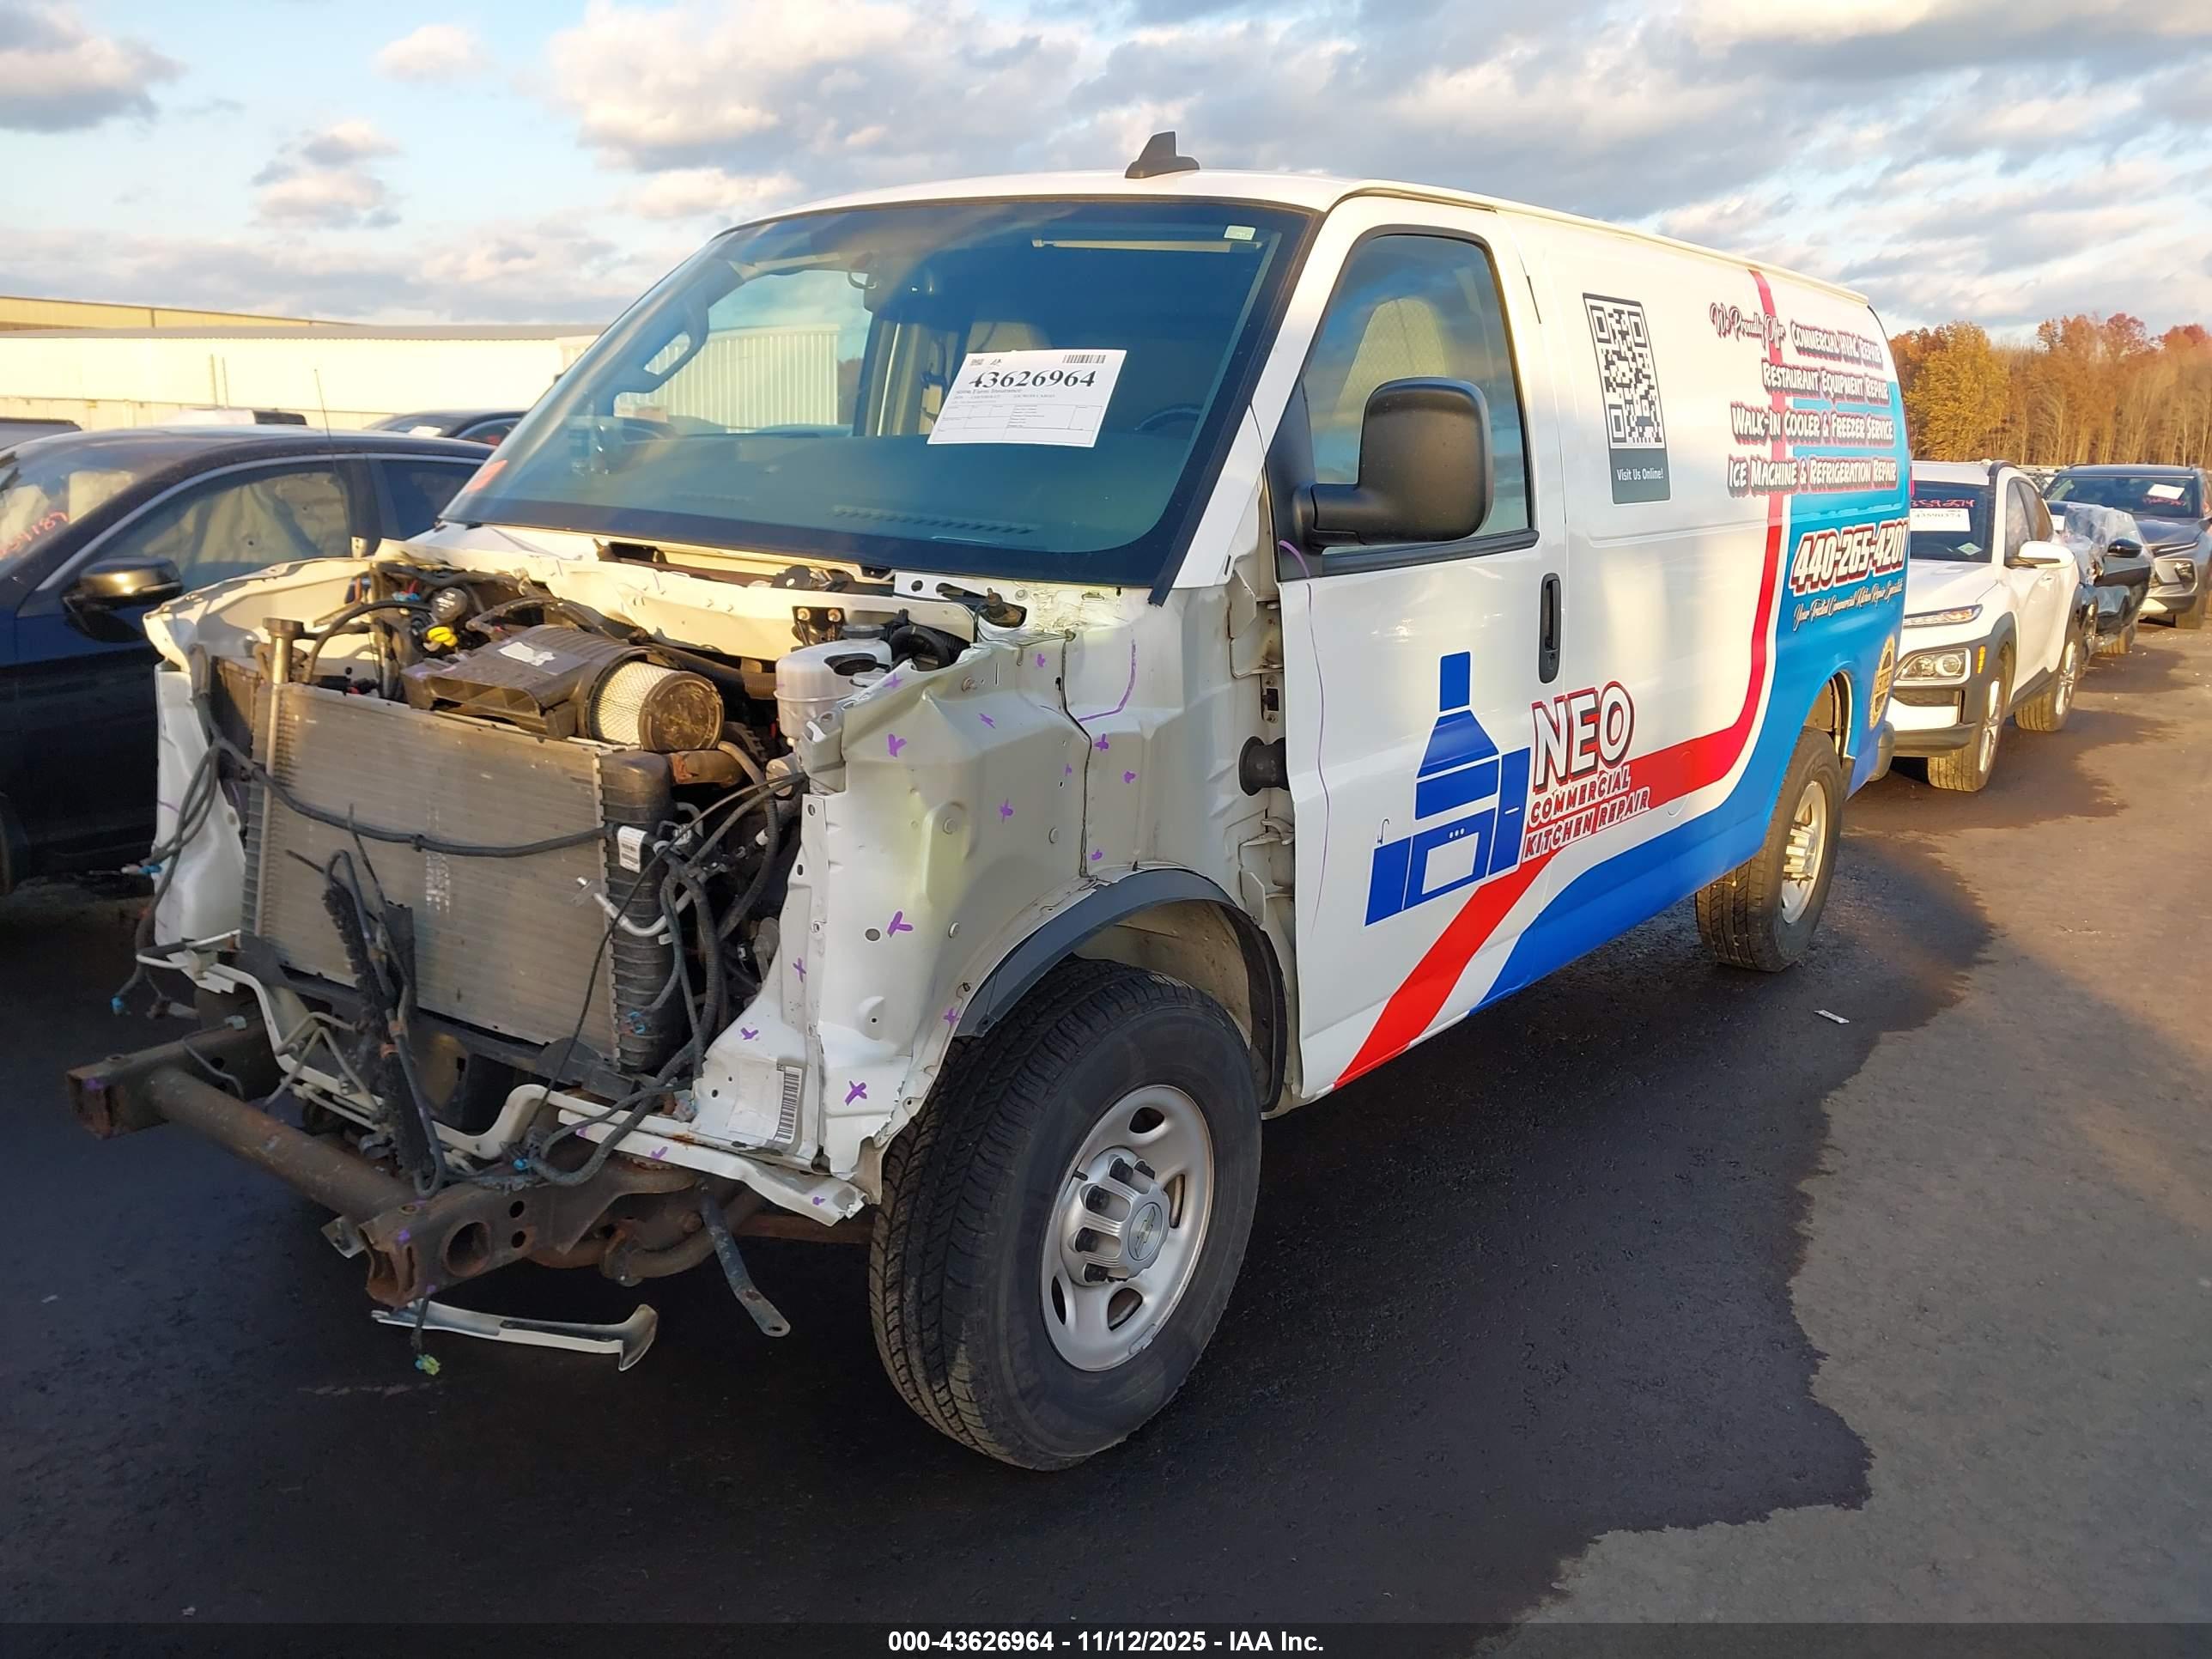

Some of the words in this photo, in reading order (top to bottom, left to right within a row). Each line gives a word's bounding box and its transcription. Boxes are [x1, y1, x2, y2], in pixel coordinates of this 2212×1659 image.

[1710, 302, 1731, 337] We
[1729, 305, 1766, 349] Proudly
[1763, 312, 1786, 349] Offer
[1790, 321, 1840, 356] COMMERCIAL
[1838, 331, 1860, 361] HVAC
[1859, 336, 1883, 366] REPAIR
[969, 370, 1097, 388] 43626964
[1762, 358, 1820, 393] RESTAURANT
[1820, 368, 1864, 399] EQUIPMENT
[1865, 375, 1889, 402] REPAIR
[1731, 405, 1781, 441] WALK-IN
[1784, 410, 1820, 441] COOLER
[1821, 413, 1829, 440] &
[1831, 413, 1866, 442] FREEZER
[1866, 415, 1894, 443] SERVICE
[1617, 468, 1632, 481] Visit
[1632, 468, 1641, 481] Us
[1642, 466, 1664, 481] Online!
[1729, 456, 1748, 492] ICE
[1750, 457, 1798, 490] MACHINE
[1799, 459, 1808, 489] &
[1809, 458, 1871, 489] REFRIGERATION
[1872, 459, 1897, 487] REPAIR
[1791, 520, 1908, 594] 440-265-4201
[1531, 680, 1635, 795] NEO
[1530, 768, 1630, 823] COMMERCIAL
[1525, 811, 1594, 859] KITCHEN
[1598, 790, 1649, 827] REPAIR
